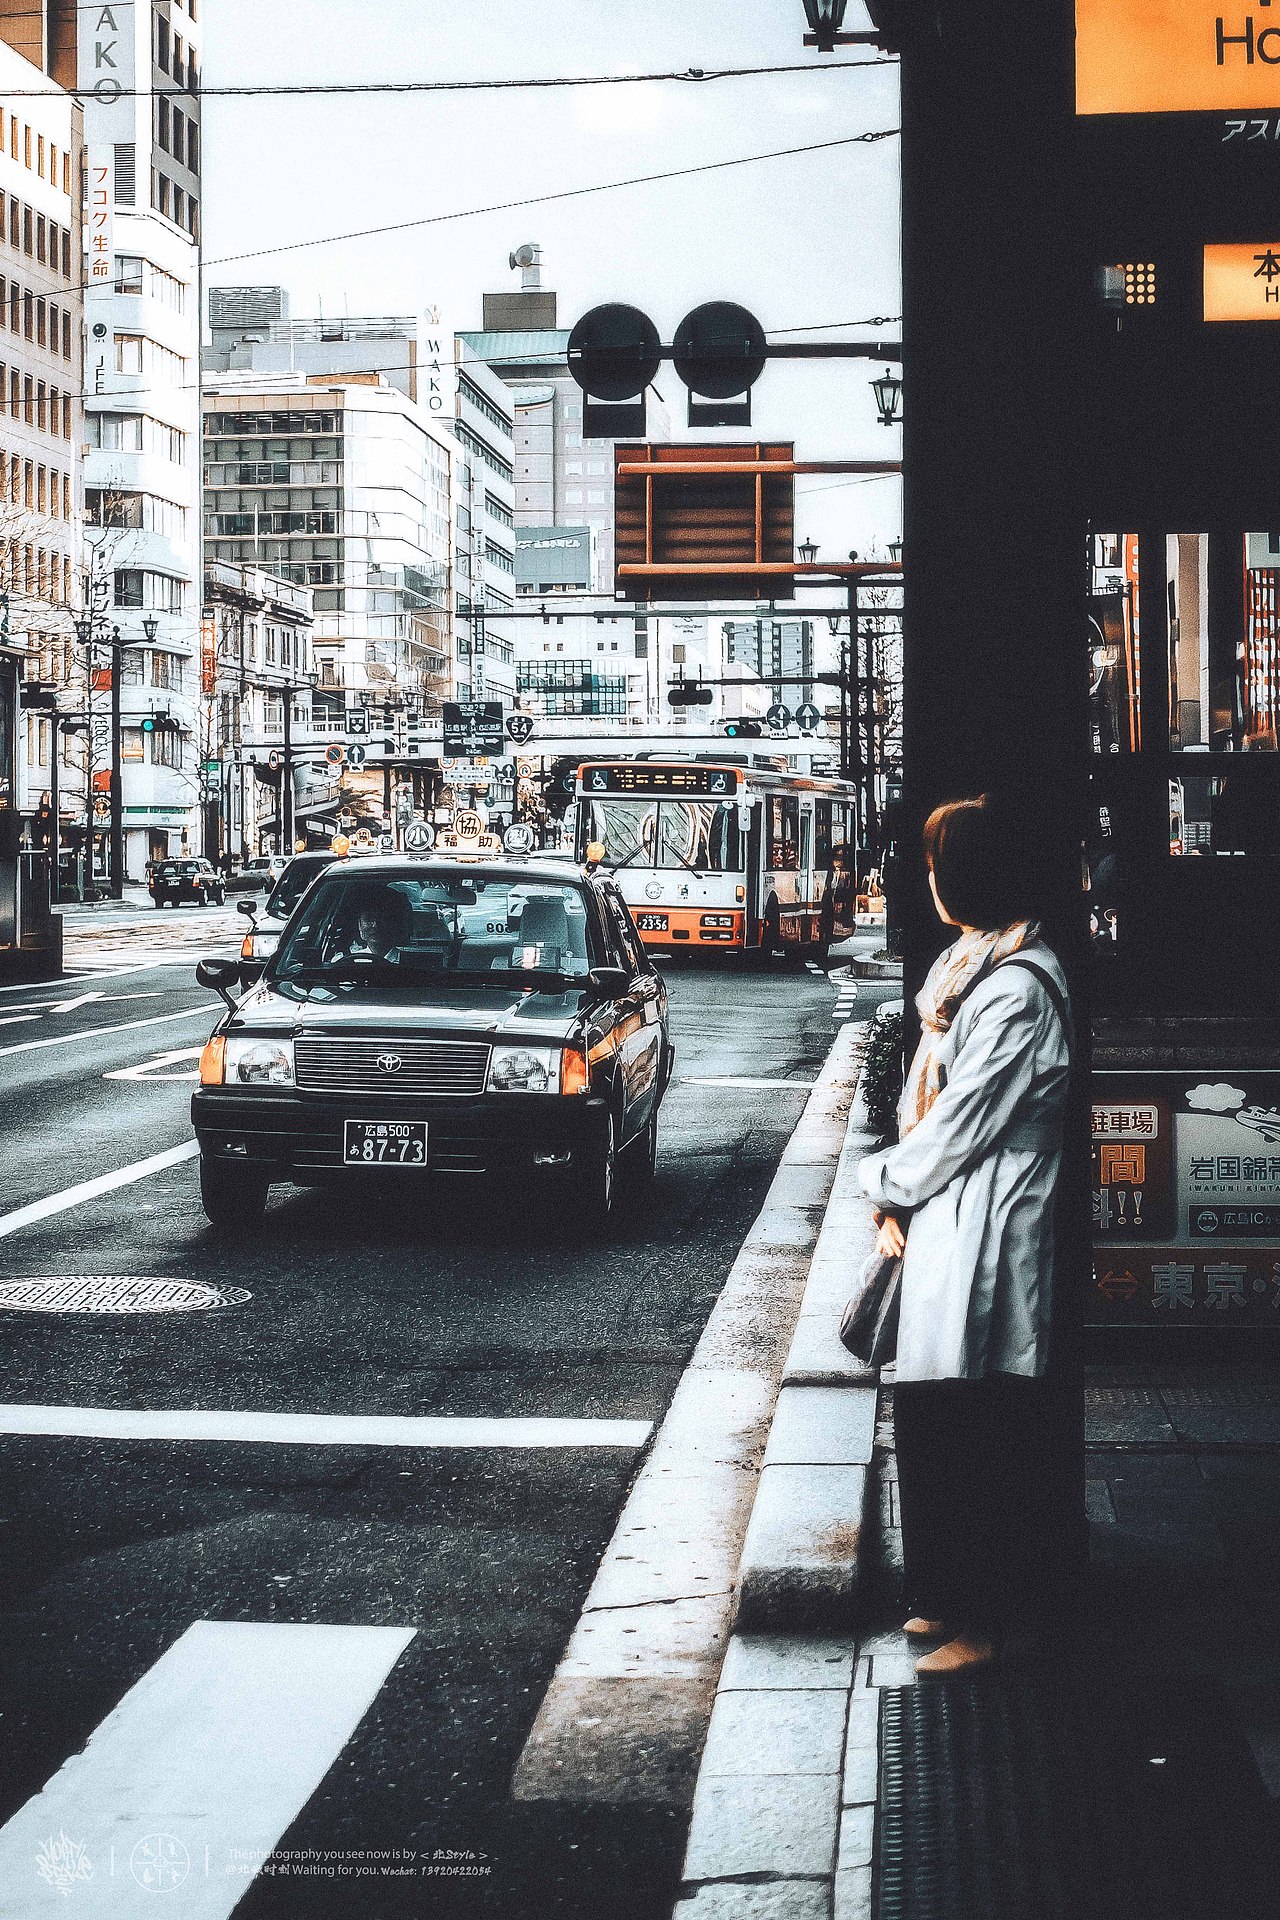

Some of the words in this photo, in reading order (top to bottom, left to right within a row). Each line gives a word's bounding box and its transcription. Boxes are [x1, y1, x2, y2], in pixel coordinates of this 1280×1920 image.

[1215, 16, 1280, 65] Ho
[92, 167, 109, 276] フコク生命
[1253, 249, 1280, 283] 本
[95, 355, 105, 396] JFE
[427, 339, 443, 411] WAKO
[511, 722, 528, 734] 54
[459, 816, 478, 835] 協
[1092, 1110, 1155, 1135] 駐車場
[349, 1144, 360, 1156] あ
[362, 1138, 424, 1163] 87-73
[1100, 1145, 1146, 1185] 間
[1189, 1184, 1240, 1192] IWAKUNI
[1151, 1261, 1280, 1309] 東京・
